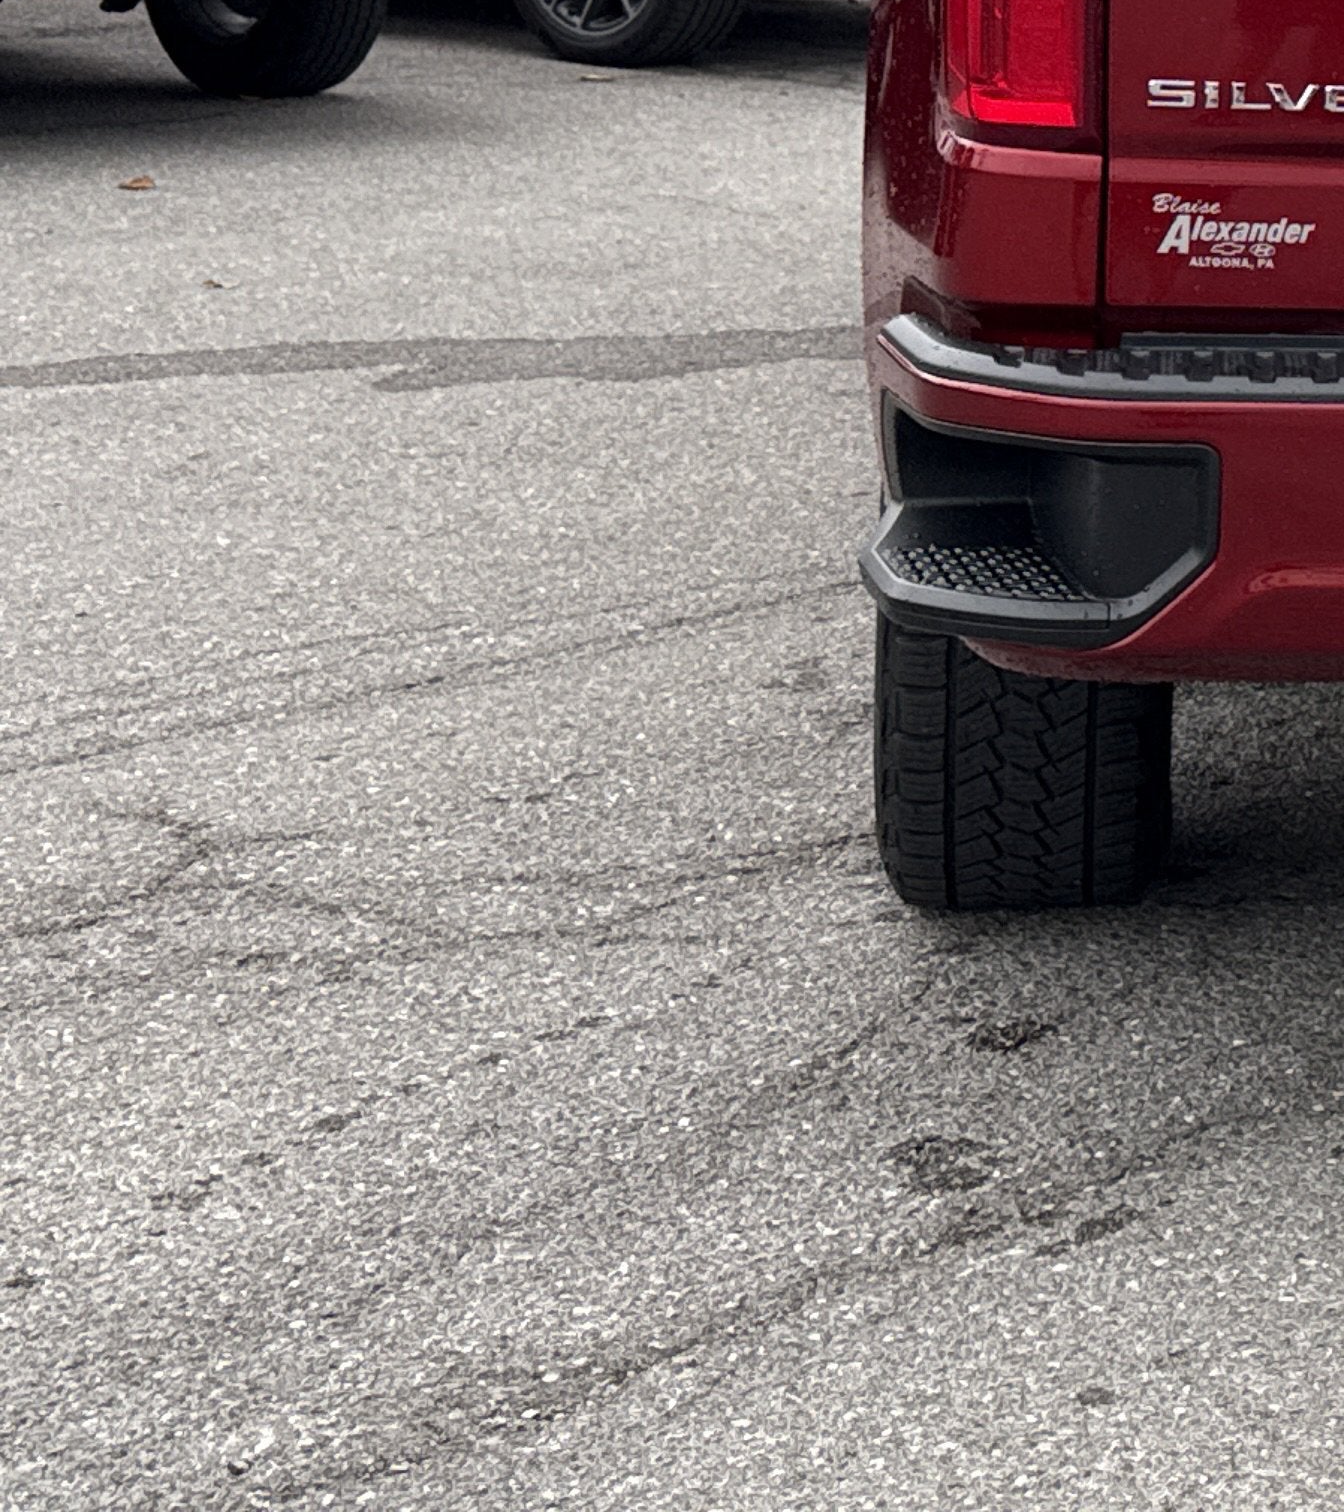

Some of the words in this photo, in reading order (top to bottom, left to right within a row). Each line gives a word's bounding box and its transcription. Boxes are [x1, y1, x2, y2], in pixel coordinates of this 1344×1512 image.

[1152, 192, 1222, 215] Blaise
[1156, 214, 1317, 254] Alexander
[1188, 255, 1255, 271] ALTOONA,
[1257, 257, 1276, 270] PA
